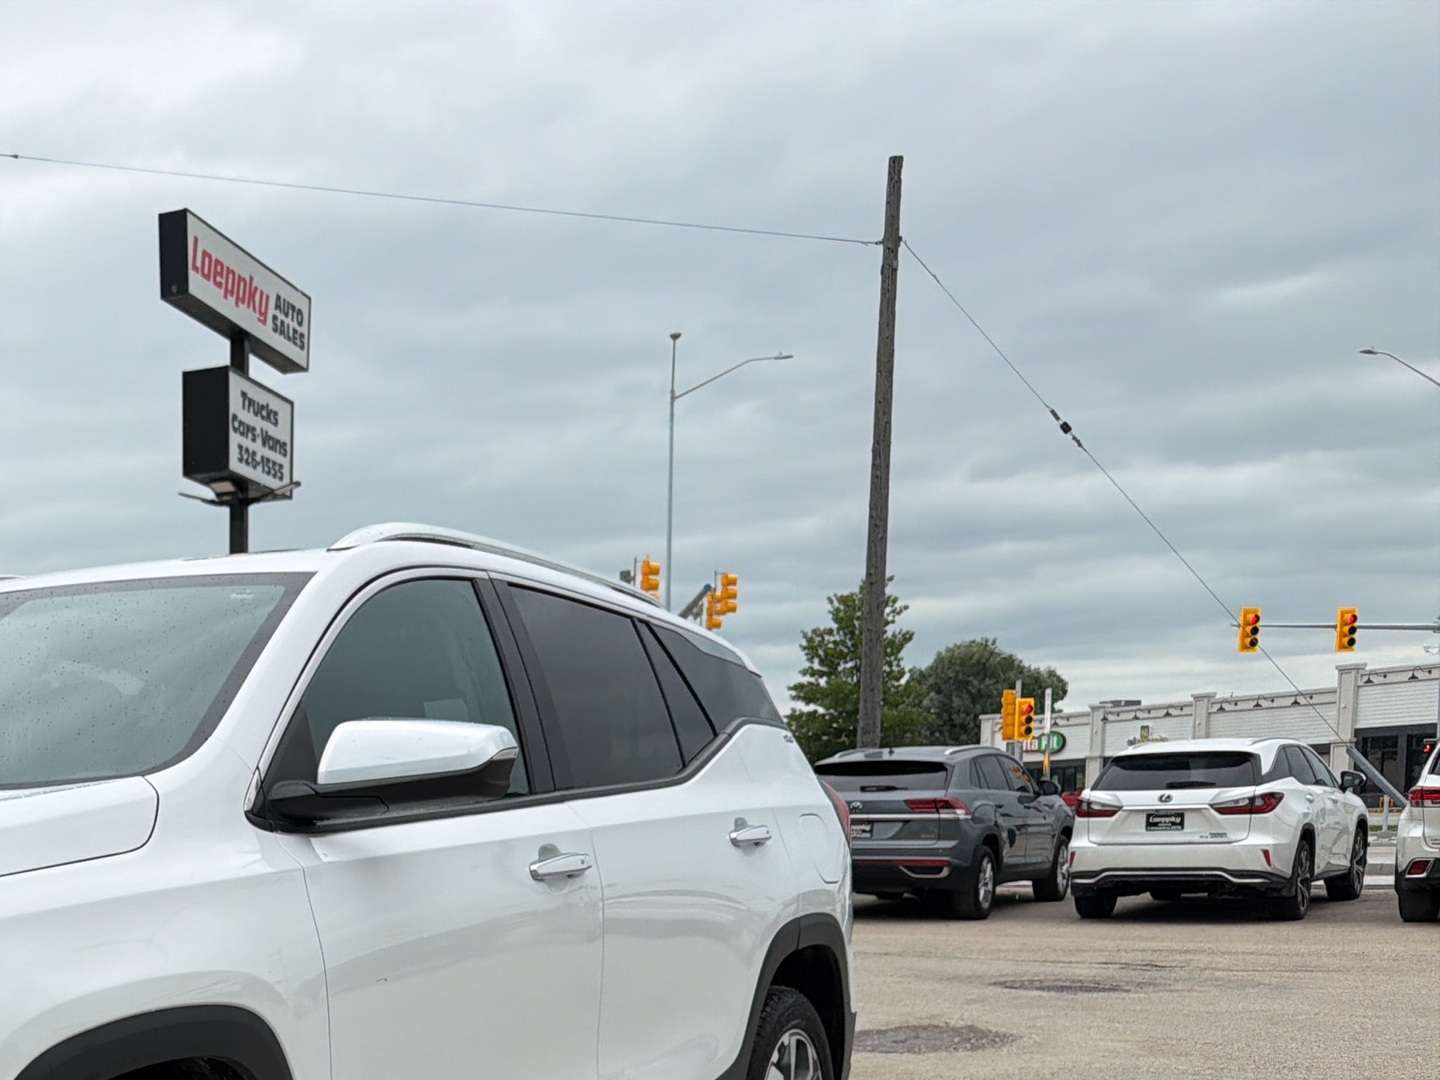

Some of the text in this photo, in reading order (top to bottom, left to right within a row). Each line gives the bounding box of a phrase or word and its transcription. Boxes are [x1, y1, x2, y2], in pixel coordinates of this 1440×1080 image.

[191, 235, 270, 326] Loeppky
[274, 293, 304, 327] AUTO
[271, 314, 305, 351] SALES
[241, 389, 279, 427] Trucks
